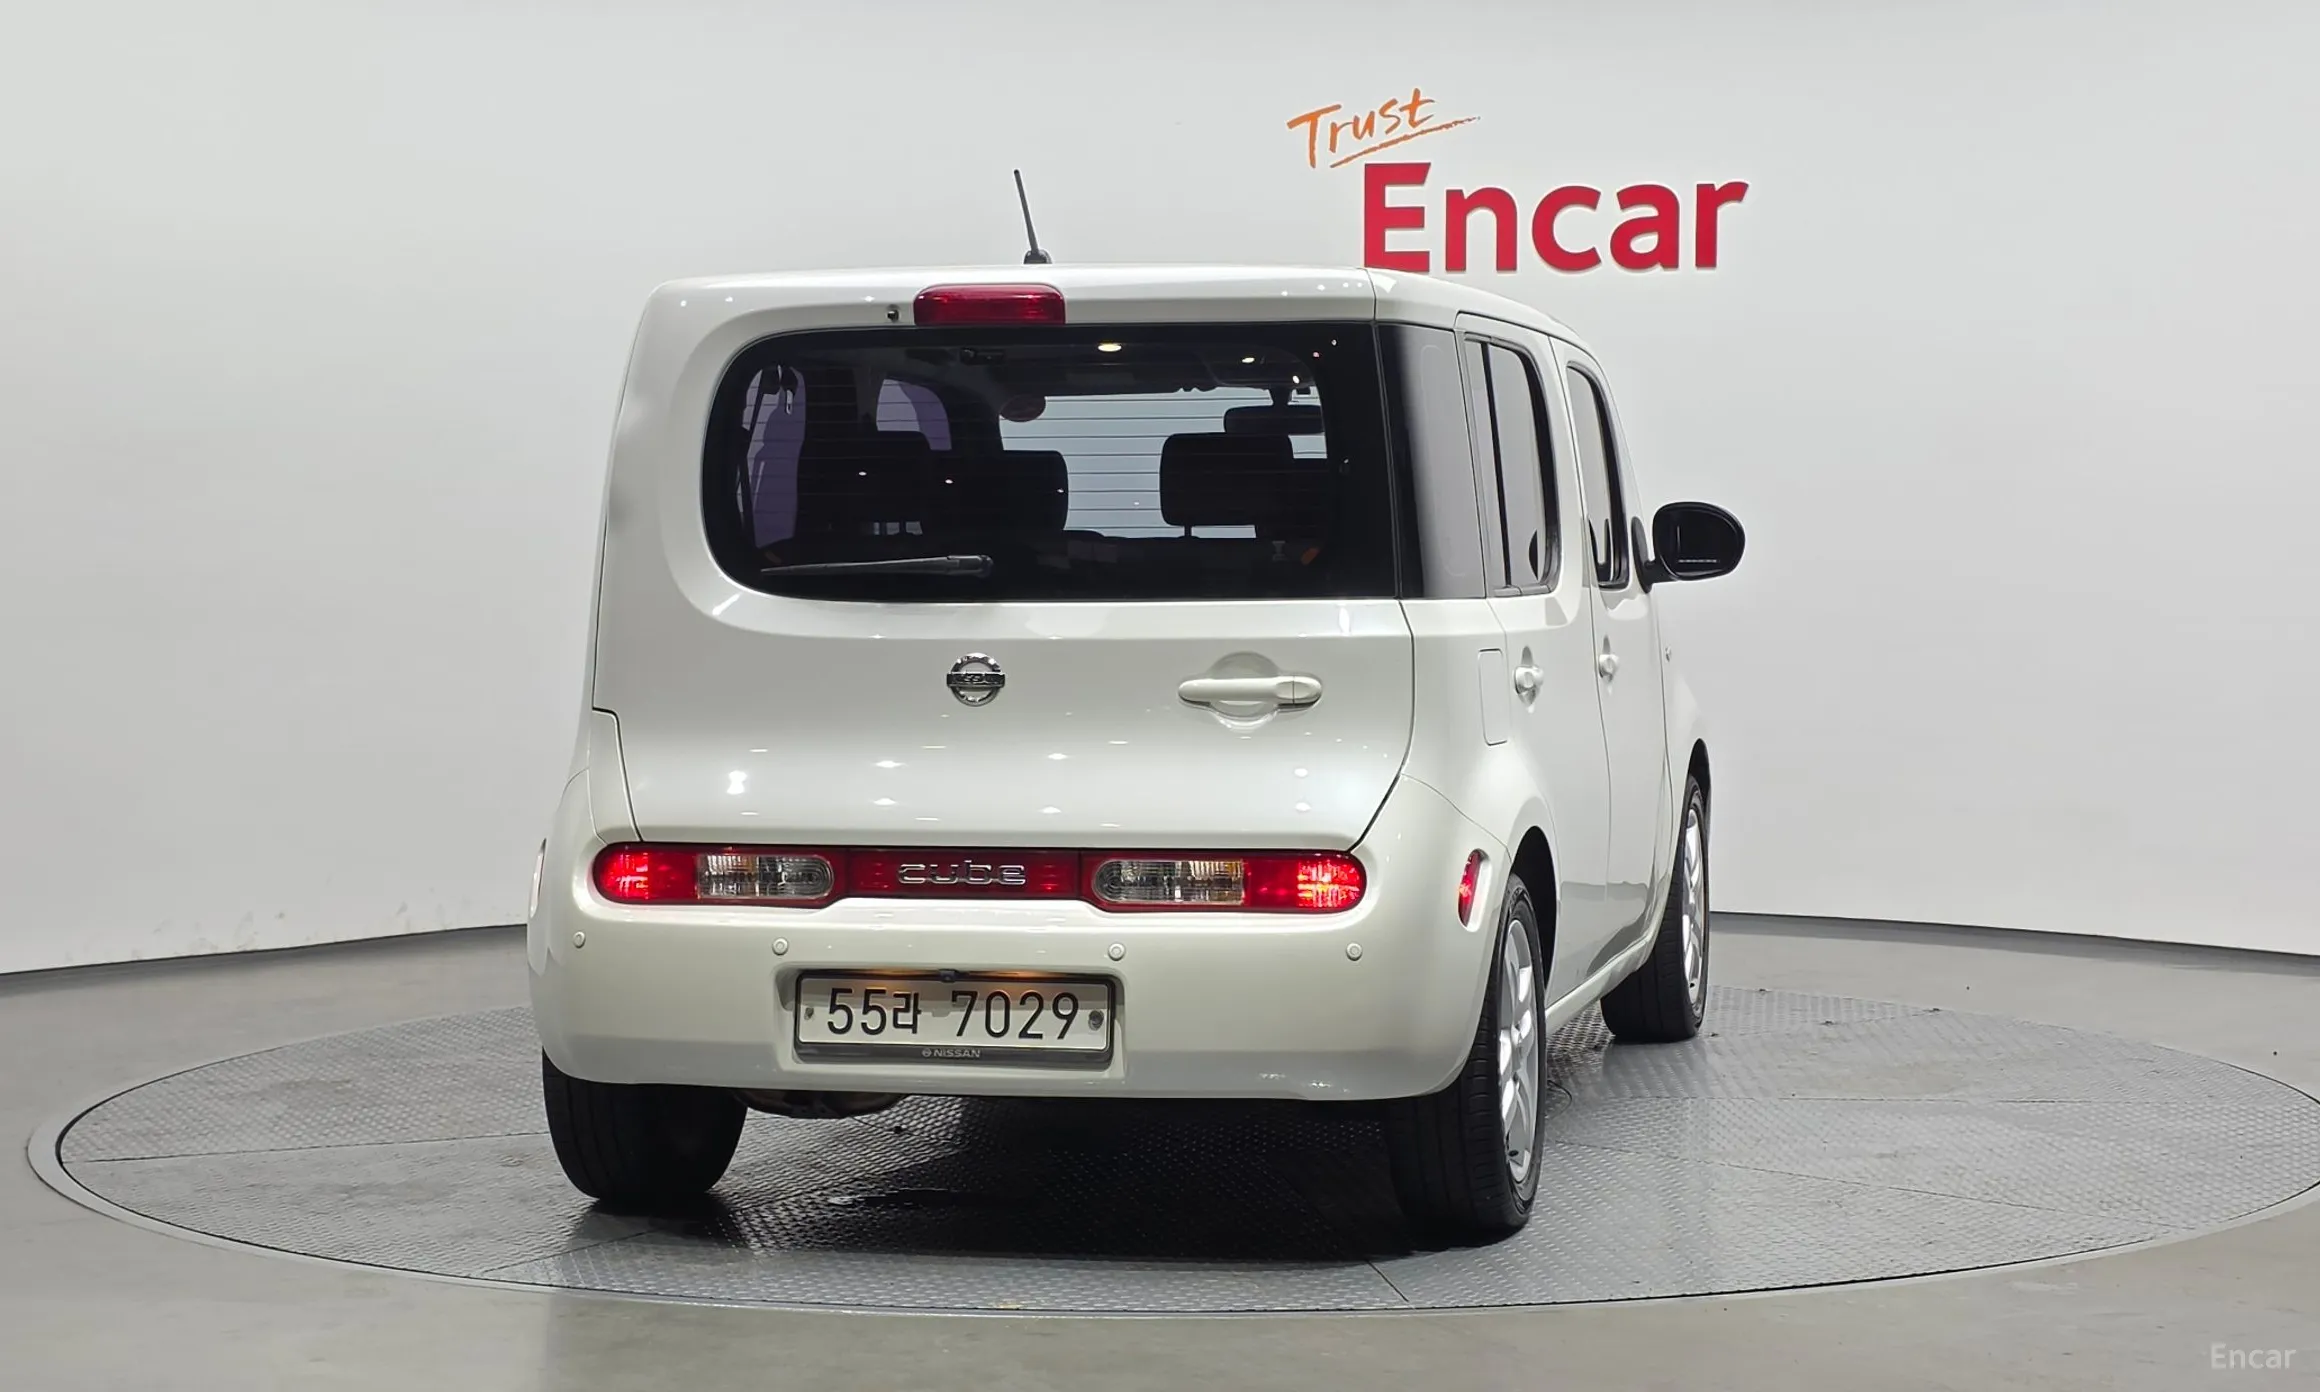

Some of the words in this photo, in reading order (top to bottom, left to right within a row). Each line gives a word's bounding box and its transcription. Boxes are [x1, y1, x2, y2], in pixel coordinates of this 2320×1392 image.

[1287, 88, 1435, 168] Trust
[1364, 162, 1749, 272] Encar
[898, 859, 1026, 886] cube
[827, 987, 921, 1036] 55라
[951, 990, 1079, 1040] 7029
[933, 1048, 980, 1058] NISSAN
